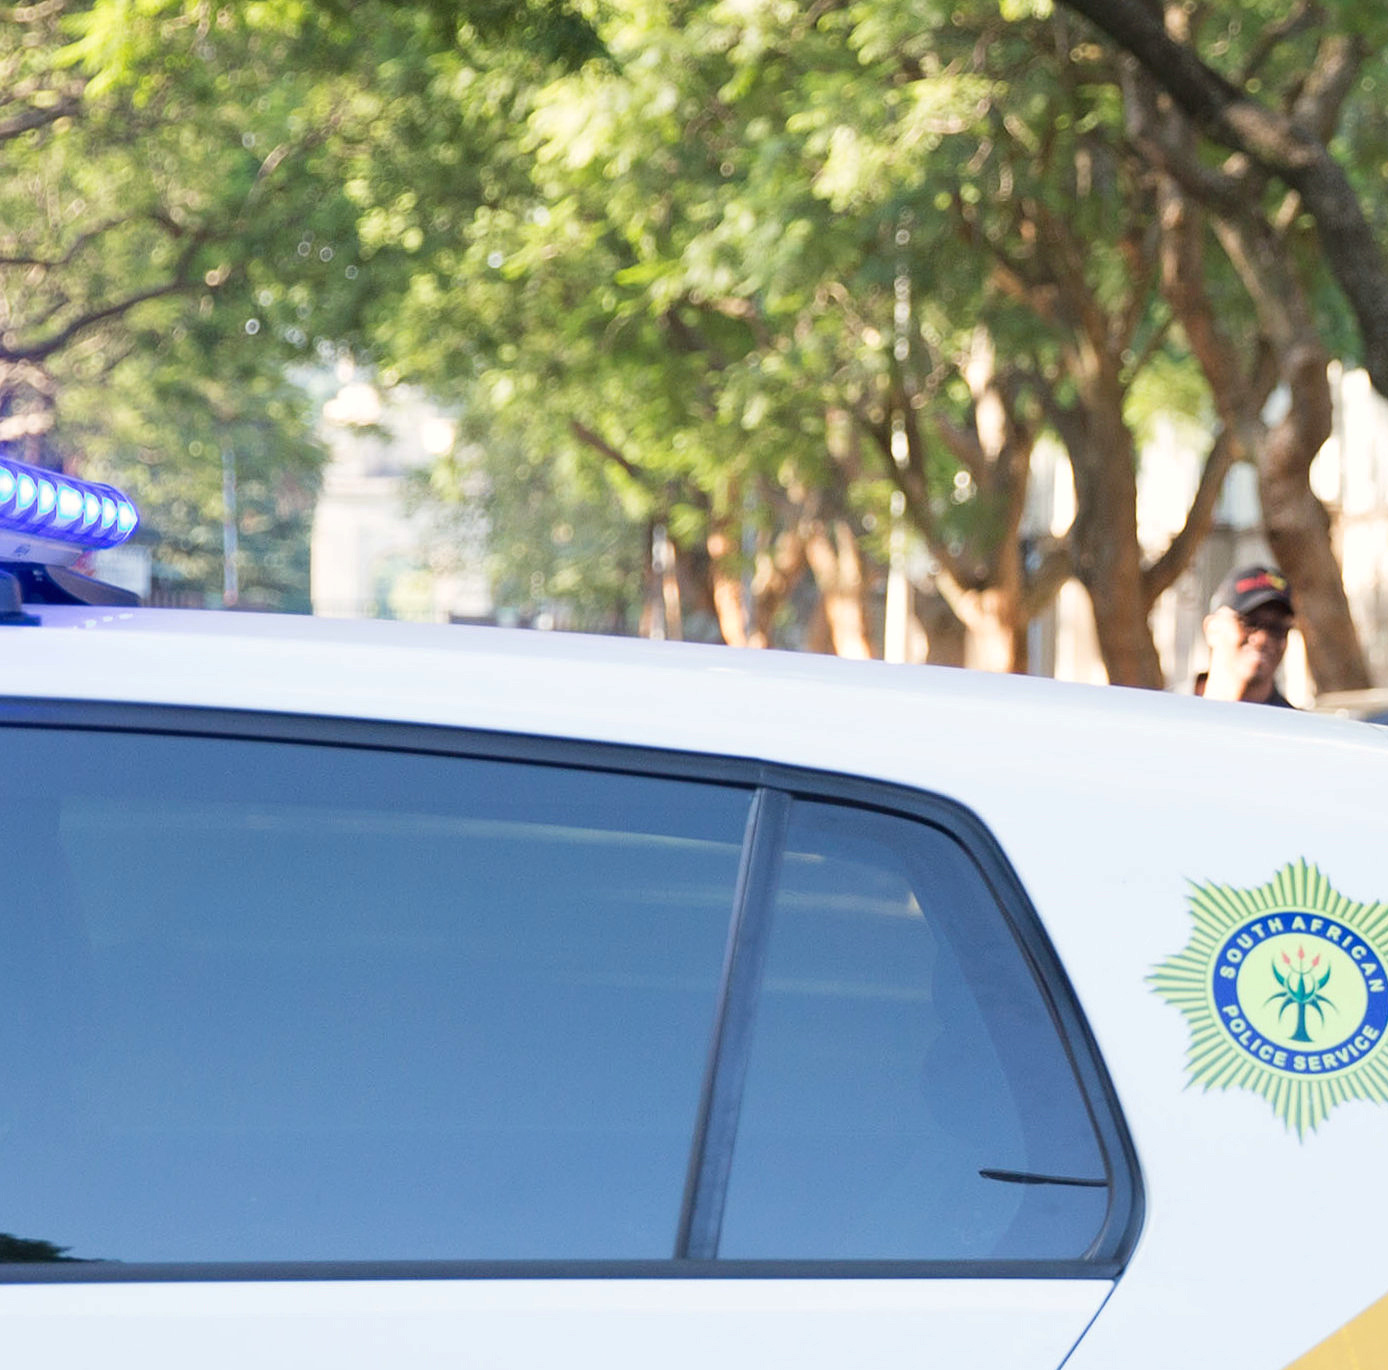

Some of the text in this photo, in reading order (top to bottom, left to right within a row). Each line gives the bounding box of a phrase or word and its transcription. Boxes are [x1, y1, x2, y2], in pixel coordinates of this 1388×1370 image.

[1220, 916, 1385, 994] SOUTH AFRICAN
[1222, 1004, 1380, 1072] POLICE SERVICE
